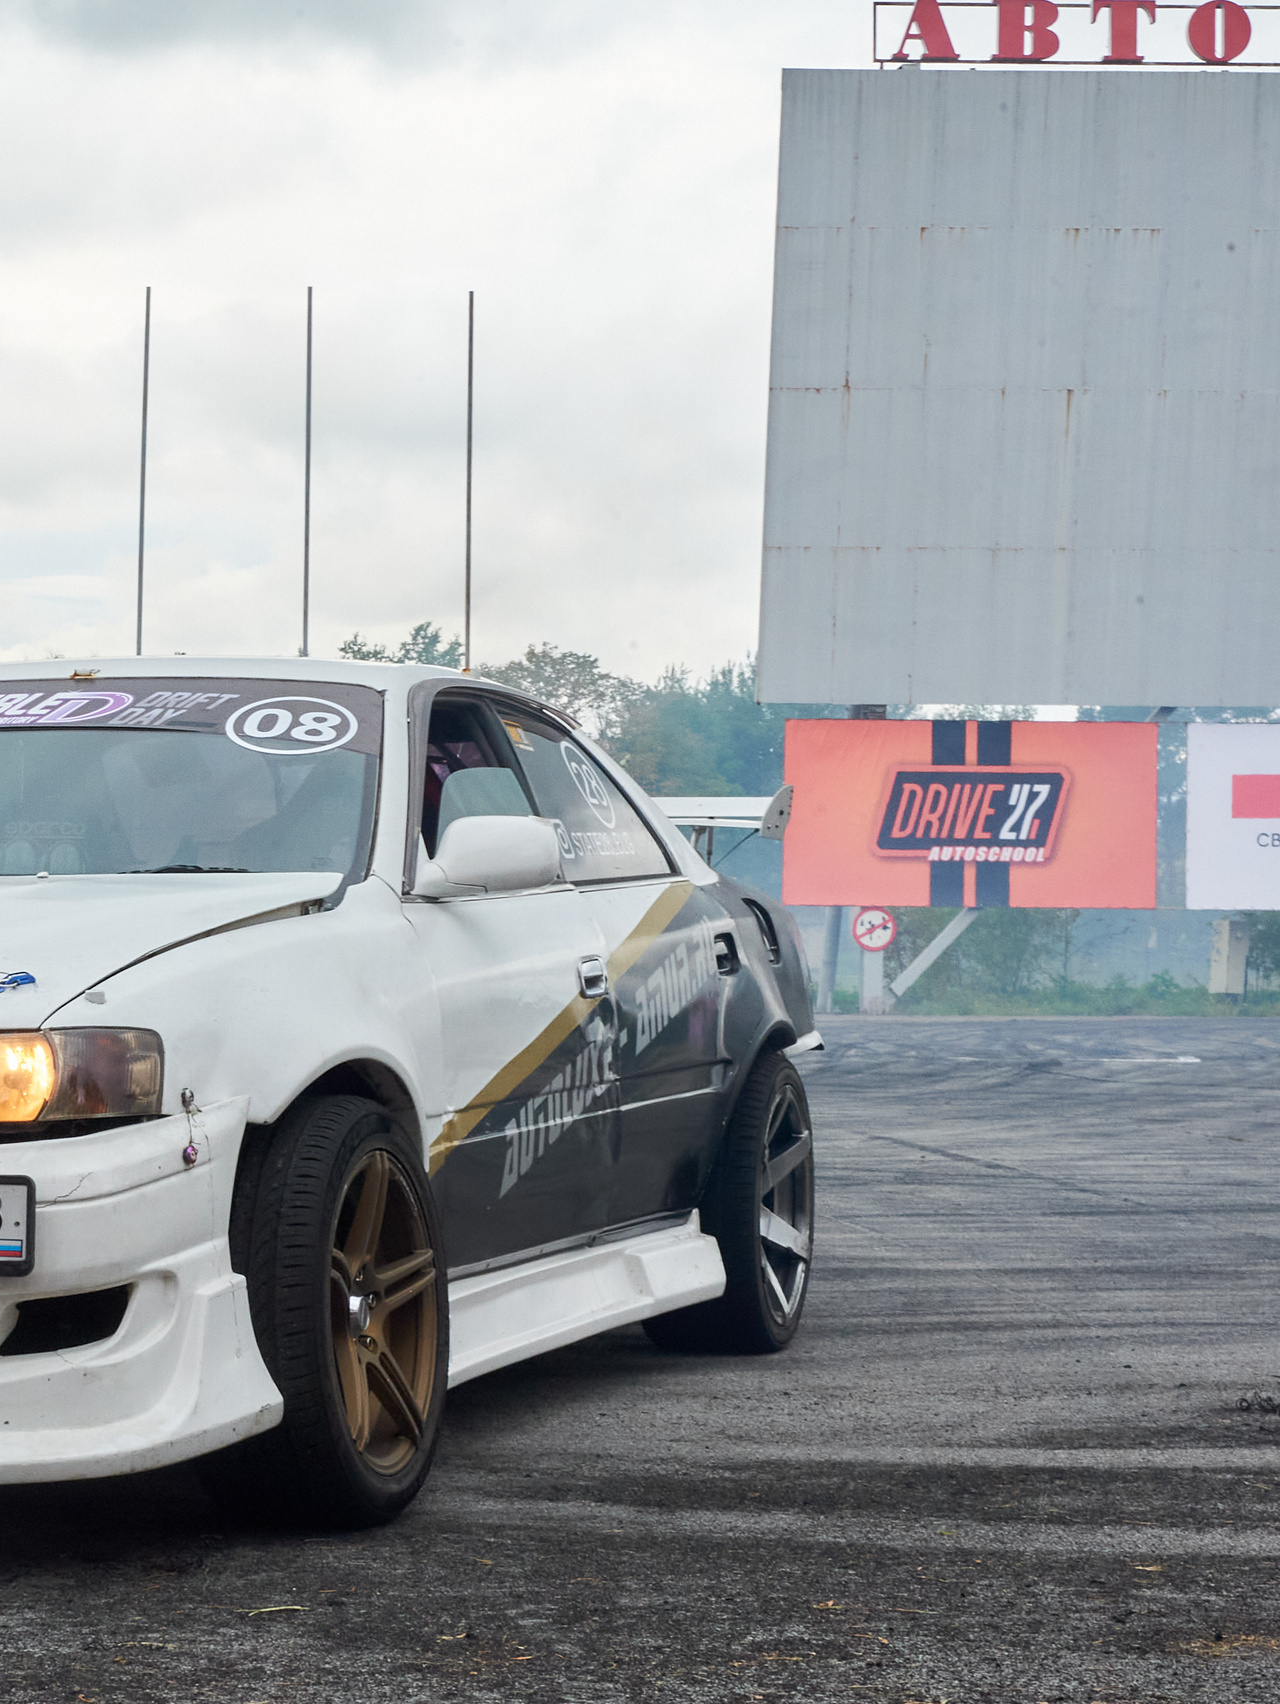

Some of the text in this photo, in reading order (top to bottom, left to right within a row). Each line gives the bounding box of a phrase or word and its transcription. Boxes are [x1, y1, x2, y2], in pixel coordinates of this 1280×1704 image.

[892, 0, 1251, 62] АВТО
[107, 708, 187, 726] DAY
[135, 692, 240, 710] DRIFT
[243, 708, 342, 742] 08
[571, 762, 607, 806] 28
[890, 783, 1051, 840] DRIVE 27
[928, 846, 1045, 862] AUTOSCHOOL
